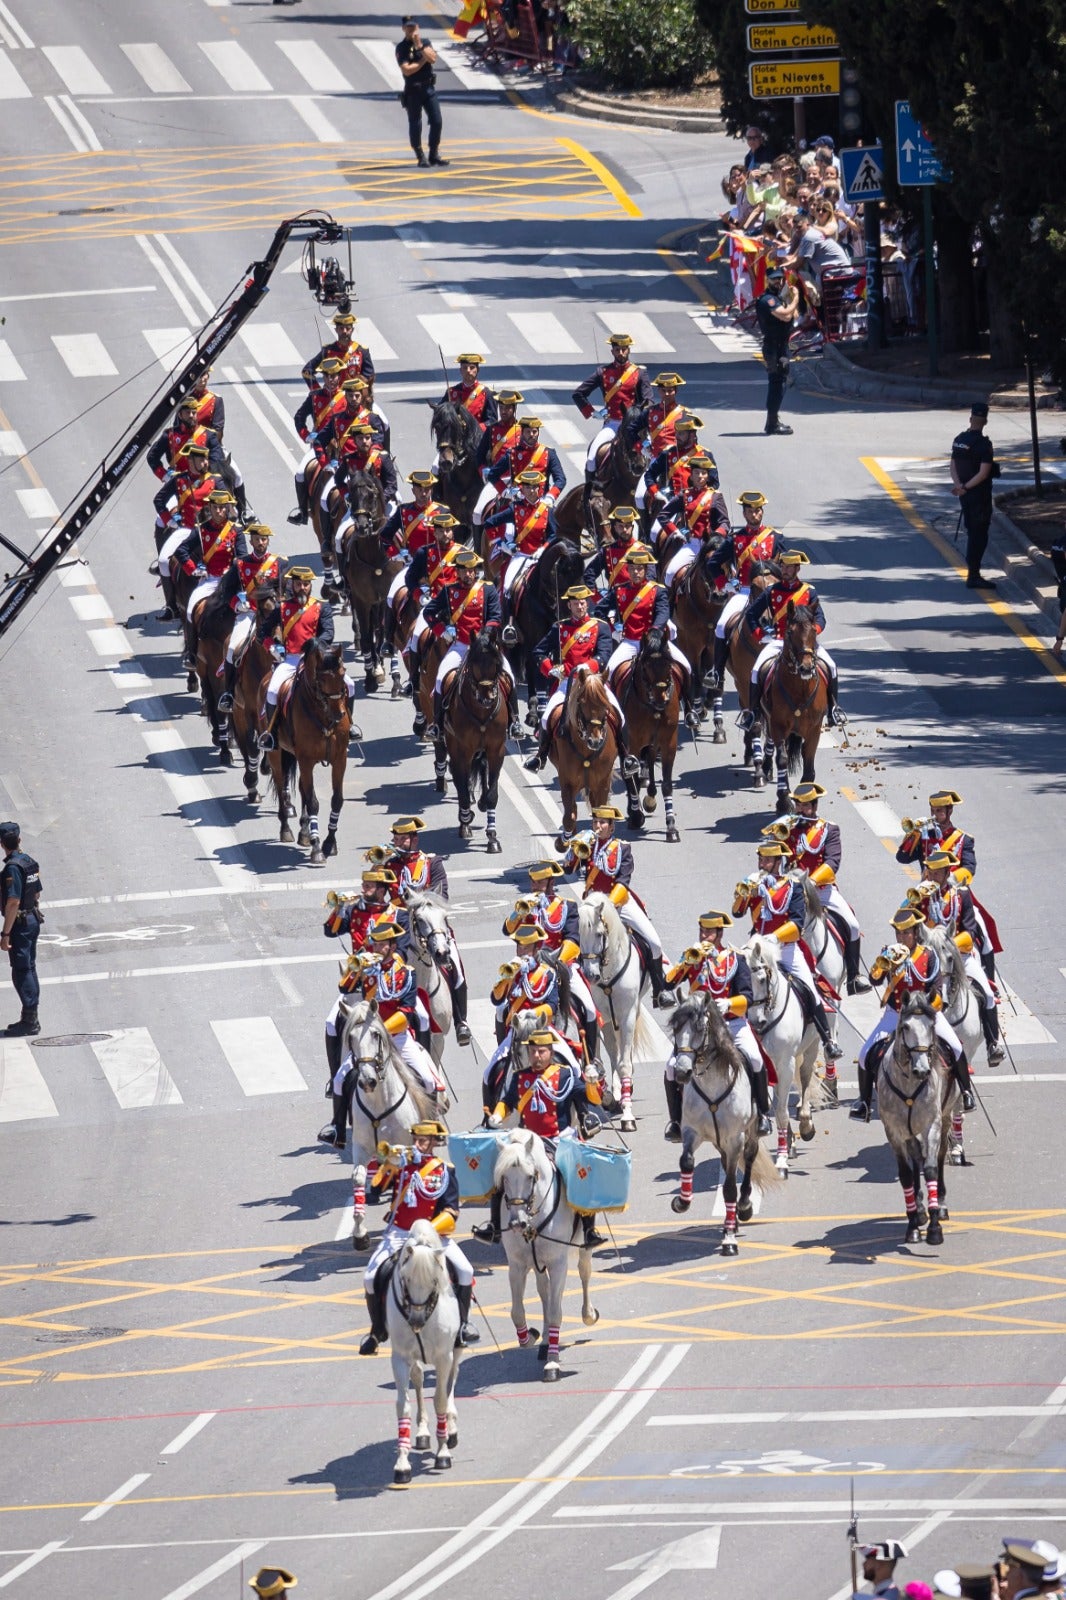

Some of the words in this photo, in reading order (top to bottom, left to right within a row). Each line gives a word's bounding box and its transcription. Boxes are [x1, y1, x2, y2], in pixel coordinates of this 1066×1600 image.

[751, 0, 775, 9] Don
[783, 0, 800, 8] Ju
[753, 28, 776, 36] Hotel
[753, 37, 787, 48] Reina
[755, 65, 777, 73] Hotel
[755, 74, 776, 84] Las
[782, 73, 825, 83] Nieves
[756, 83, 832, 95] Sacromonte
[112, 443, 139, 477] MovieTech
